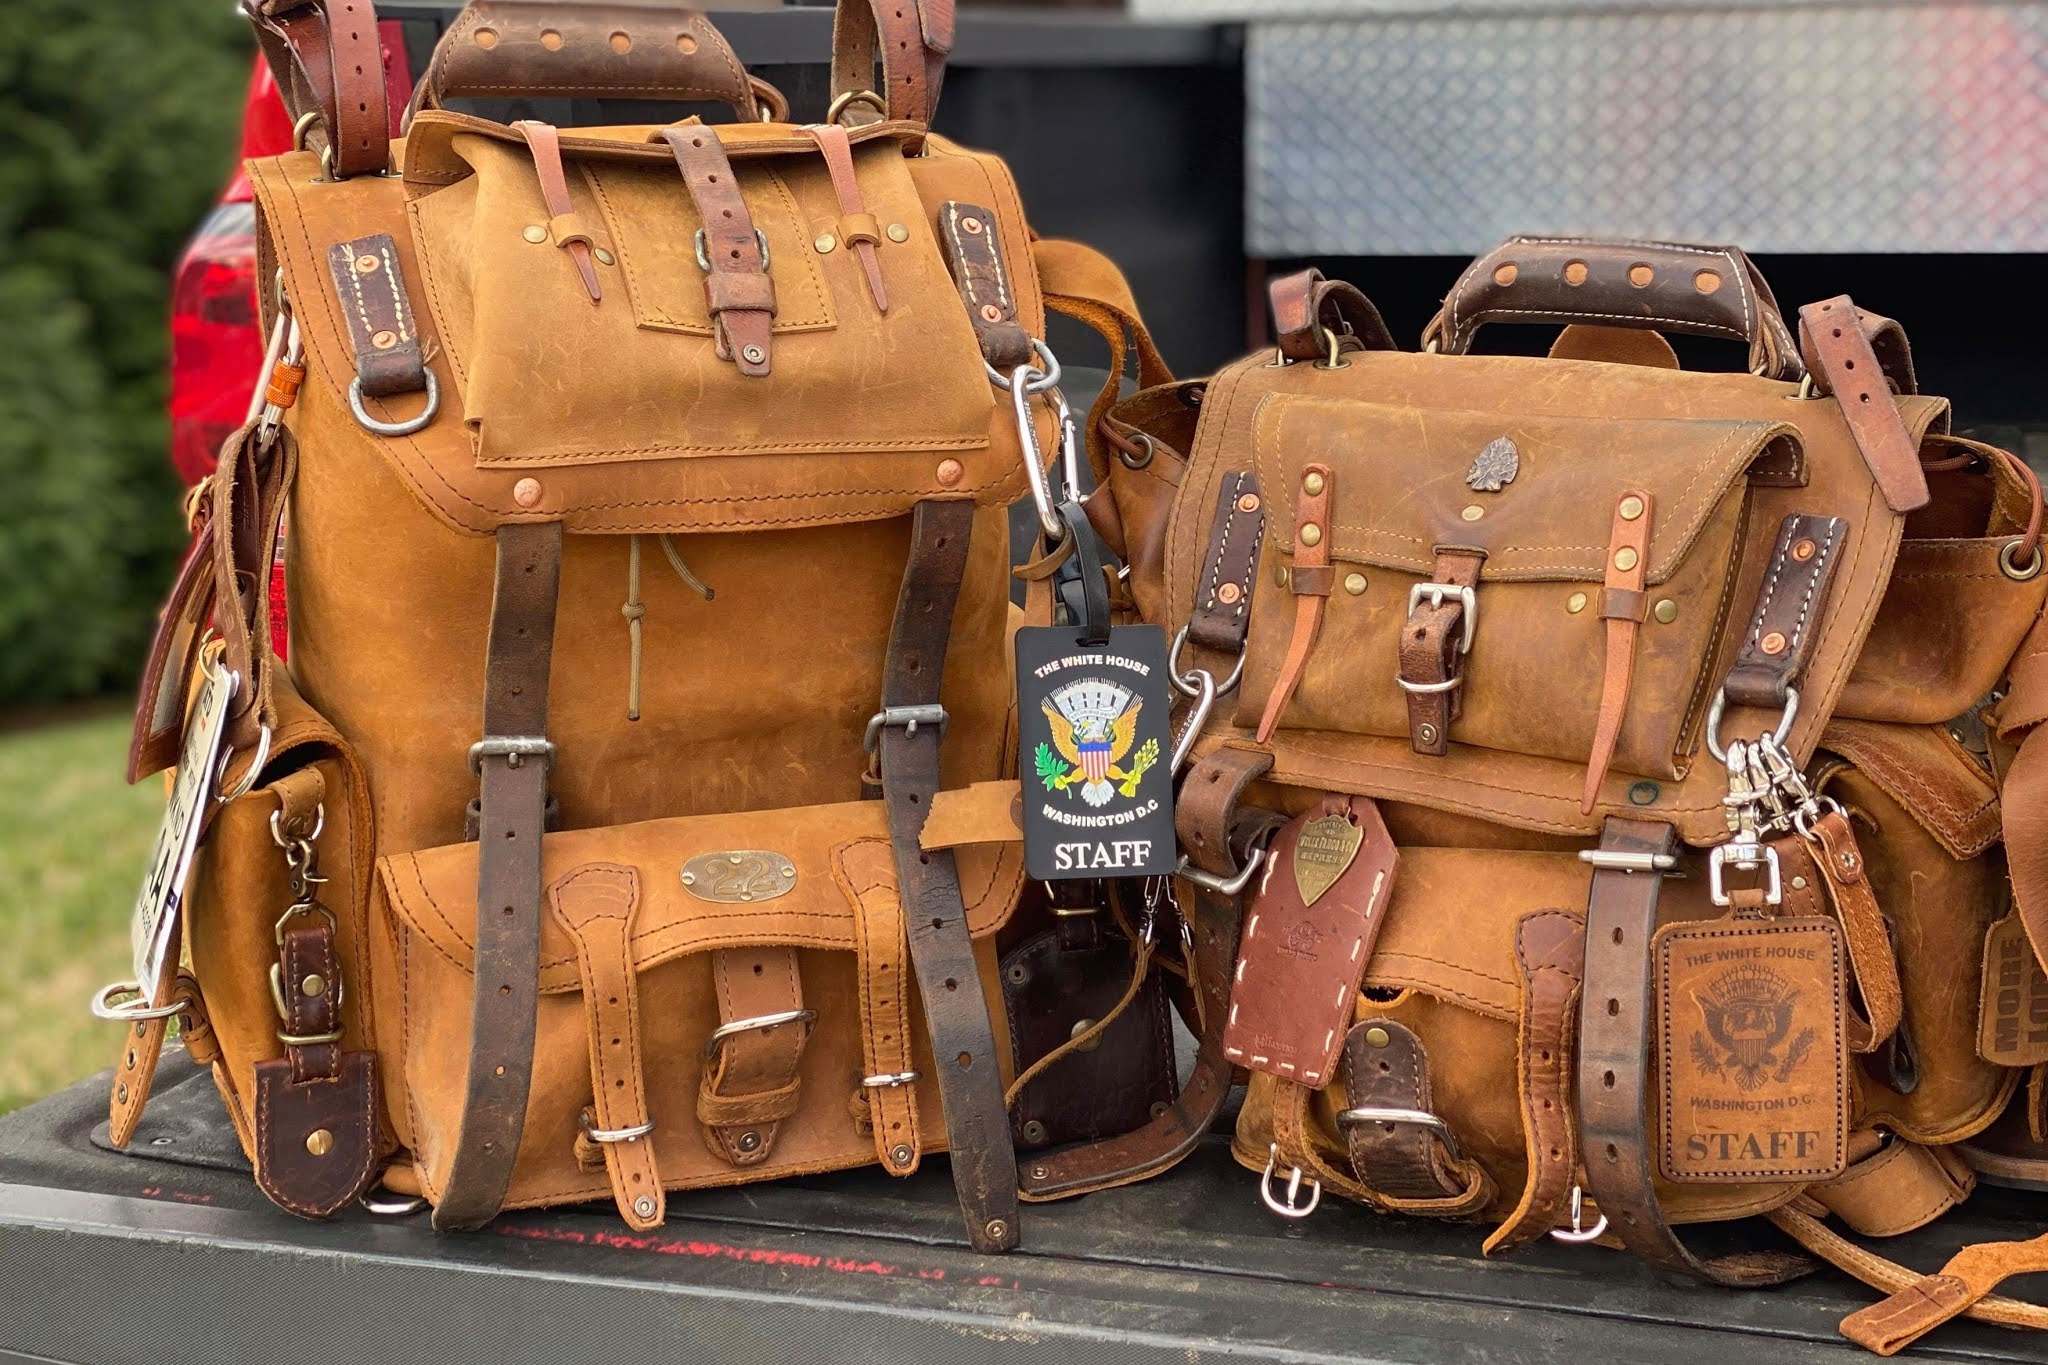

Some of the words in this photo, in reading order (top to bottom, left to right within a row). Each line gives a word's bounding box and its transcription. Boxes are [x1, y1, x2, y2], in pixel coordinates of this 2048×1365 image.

[1034, 662, 1061, 679] THE
[1061, 654, 1104, 671] WHITE
[1105, 655, 1151, 678] HOUSE
[1042, 803, 1134, 828] WASHINGTON
[1135, 798, 1160, 818] D.C
[1055, 840, 1152, 871] STAFF
[704, 858, 778, 896] 22
[1685, 953, 1714, 968] THE
[1716, 947, 1762, 960] WHITE
[1765, 946, 1816, 961] HOUSE
[1994, 937, 2023, 1052] MORE
[1690, 1096, 1784, 1112] WASHINGTON
[1788, 1094, 1817, 1108] D.C.
[1686, 1130, 1821, 1162] STAFF
